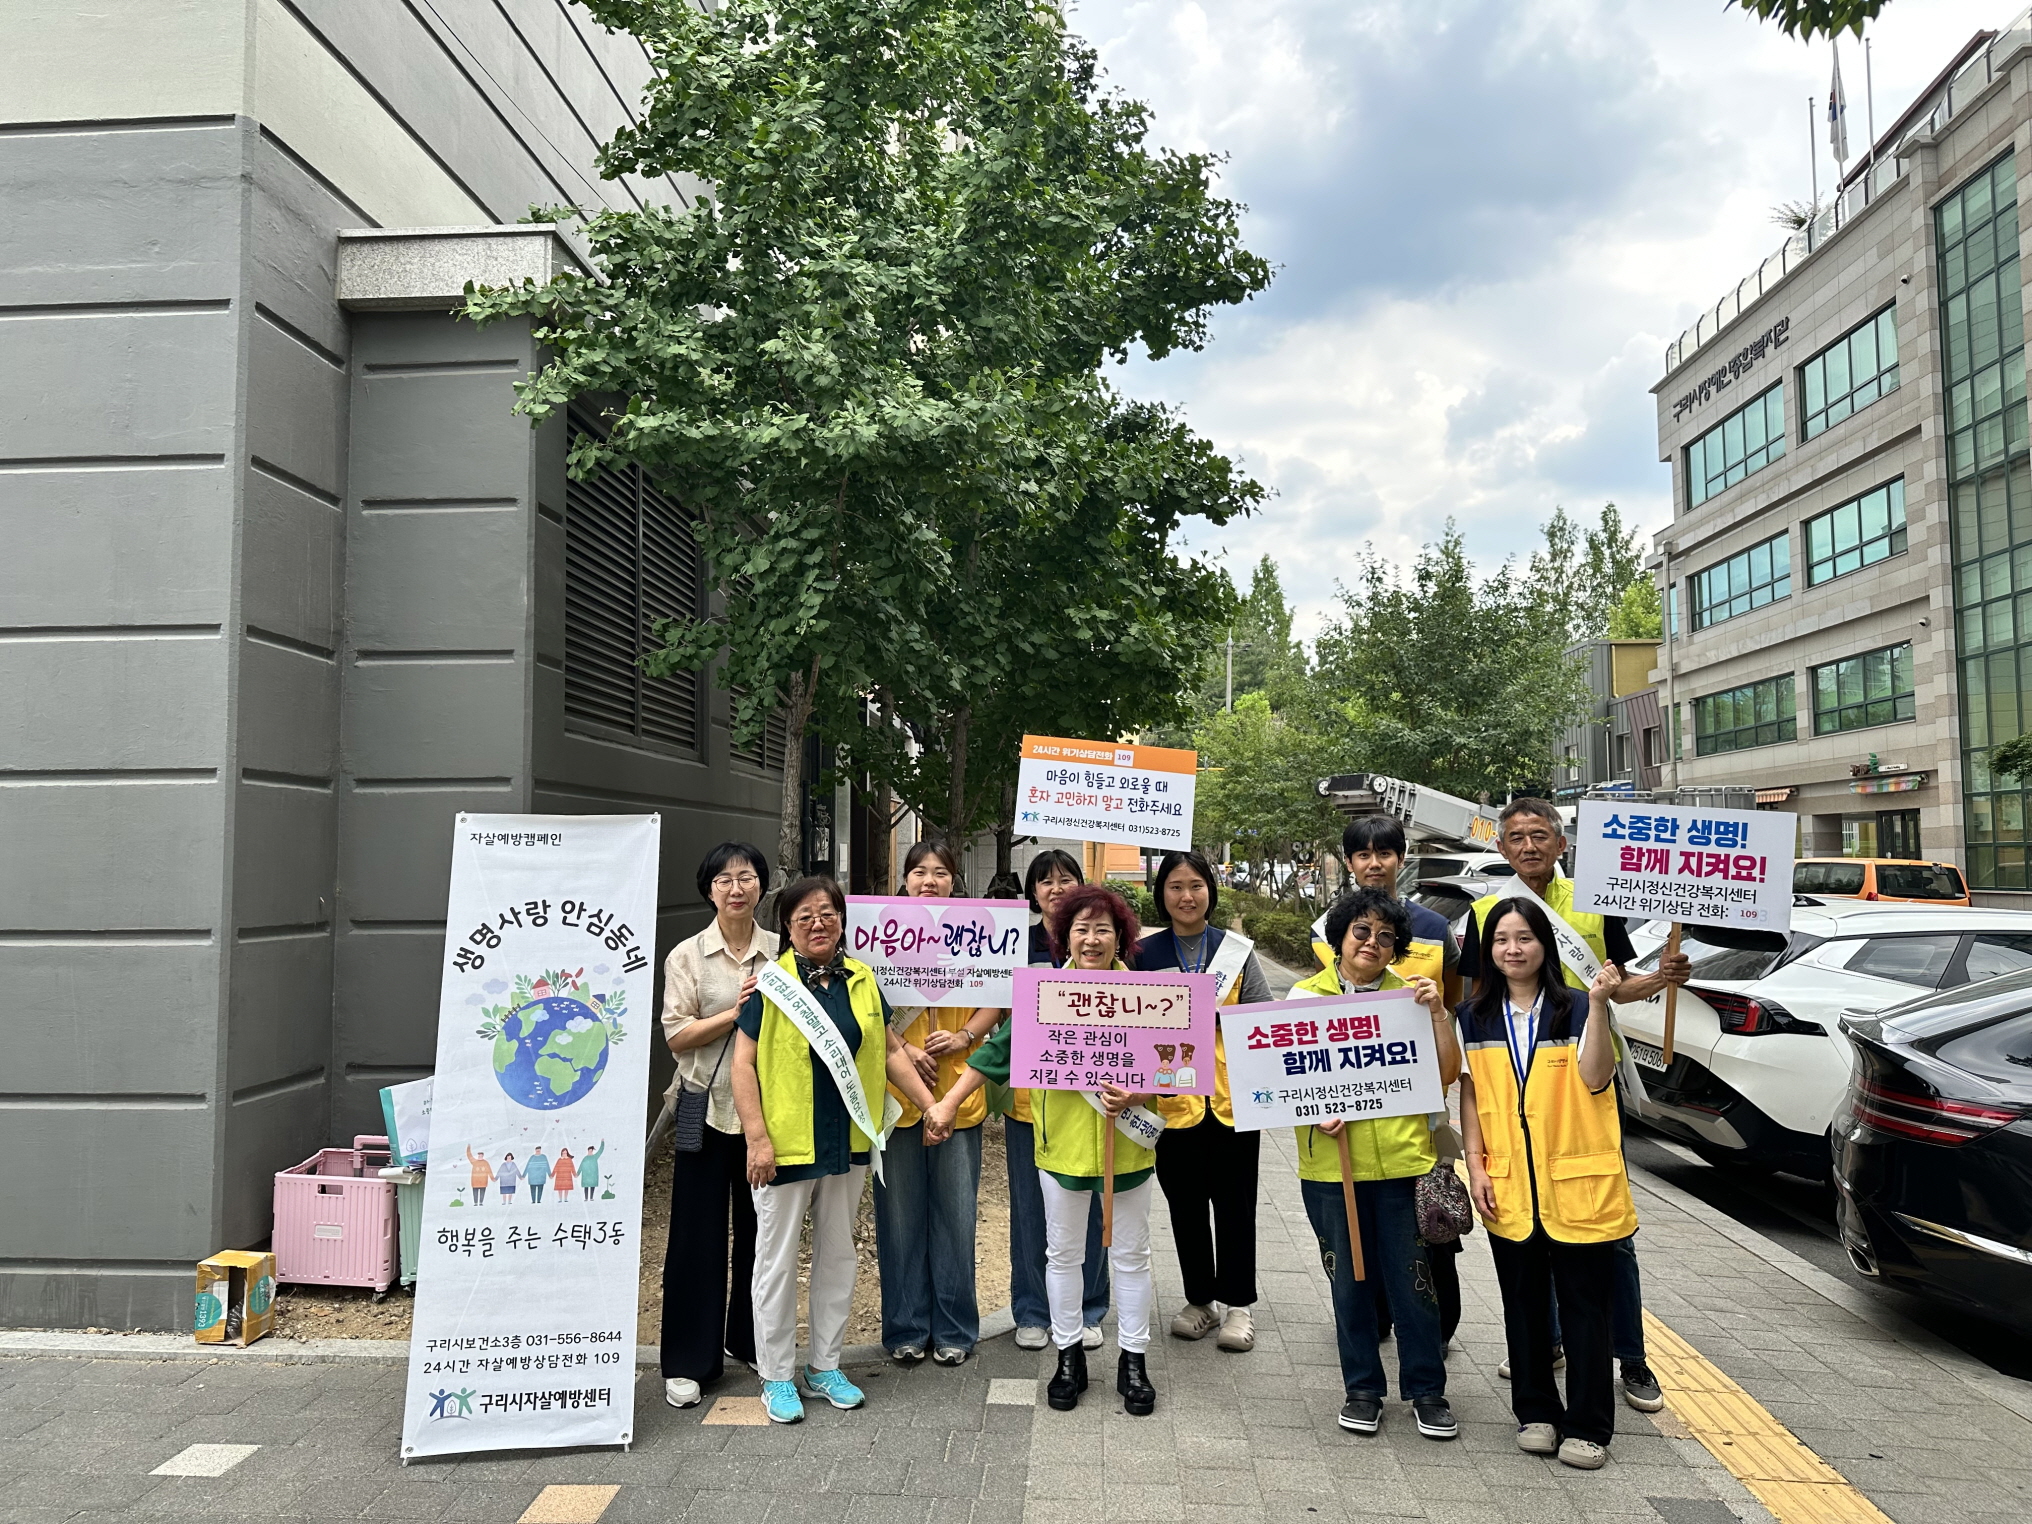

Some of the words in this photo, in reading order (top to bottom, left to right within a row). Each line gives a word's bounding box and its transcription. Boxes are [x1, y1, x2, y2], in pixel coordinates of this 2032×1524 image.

[1672, 316, 1790, 423] 구리시장애인종합복지관
[1032, 744, 1060, 756] 24시간
[1062, 747, 1114, 761] 위기상담전화
[1117, 754, 1131, 762] 109
[1046, 768, 1080, 786] 마음이
[1084, 770, 1115, 789] 힘들고
[1118, 777, 1151, 795] 외로울
[1155, 780, 1168, 793] 때
[1028, 786, 1051, 804] 혼자
[1054, 791, 1098, 807] 고민하지
[1102, 795, 1124, 812] 말고
[1127, 797, 1183, 816] 전화주세요
[469, 832, 562, 847] 자살예방캠페인
[1042, 815, 1125, 832] 구리시정신건강복지센터
[1128, 824, 1181, 837] 031)523-8725
[1602, 813, 1680, 844] 소중한
[1687, 818, 1749, 849] 생명!
[1620, 845, 1670, 875] 함께
[1678, 850, 1767, 883] 지켜요!
[1606, 877, 1757, 904] 구리시정신건강복지센터
[1593, 893, 1636, 911] 24시간
[1638, 897, 1694, 916] 위기상담
[1697, 903, 1729, 920] 전화:
[1740, 909, 1757, 919] 109
[452, 899, 551, 973] 생명사랑
[560, 900, 648, 974] 안심동네
[883, 977, 911, 988] 24시간
[913, 978, 964, 989] 위기상담전화
[969, 980, 984, 988] 109
[947, 967, 965, 977] 부설
[1048, 1029, 1078, 1045] 작은
[1082, 1031, 1128, 1047] 관심이
[1247, 1020, 1319, 1050] 소중한
[1326, 1014, 1382, 1043] 생명!
[823, 1038, 852, 1079] 소리내어
[1039, 1049, 1085, 1066] 소중한
[1090, 1051, 1136, 1068] 생명을
[1282, 1048, 1332, 1076] 함께
[1338, 1040, 1418, 1070] 지켜요!
[1648, 1050, 1665, 1069] 506
[1029, 1069, 1058, 1085] 지킬
[1064, 1070, 1079, 1085] 수
[1278, 1077, 1413, 1104] 구리시정신건강복지센터
[1295, 1103, 1320, 1117] 031)
[1325, 1098, 1383, 1115] 523-8725
[437, 1226, 496, 1258] 행복을
[505, 1225, 541, 1250] 주는
[551, 1221, 625, 1250] 수택3동
[425, 1335, 522, 1353] 구리시보건소3층
[526, 1330, 623, 1347] 031-556-8644
[423, 1359, 472, 1374] 24시간
[476, 1353, 588, 1372] 자살예방상담전화
[593, 1352, 620, 1364] 109
[479, 1386, 612, 1413] 구리시자살예방센터
